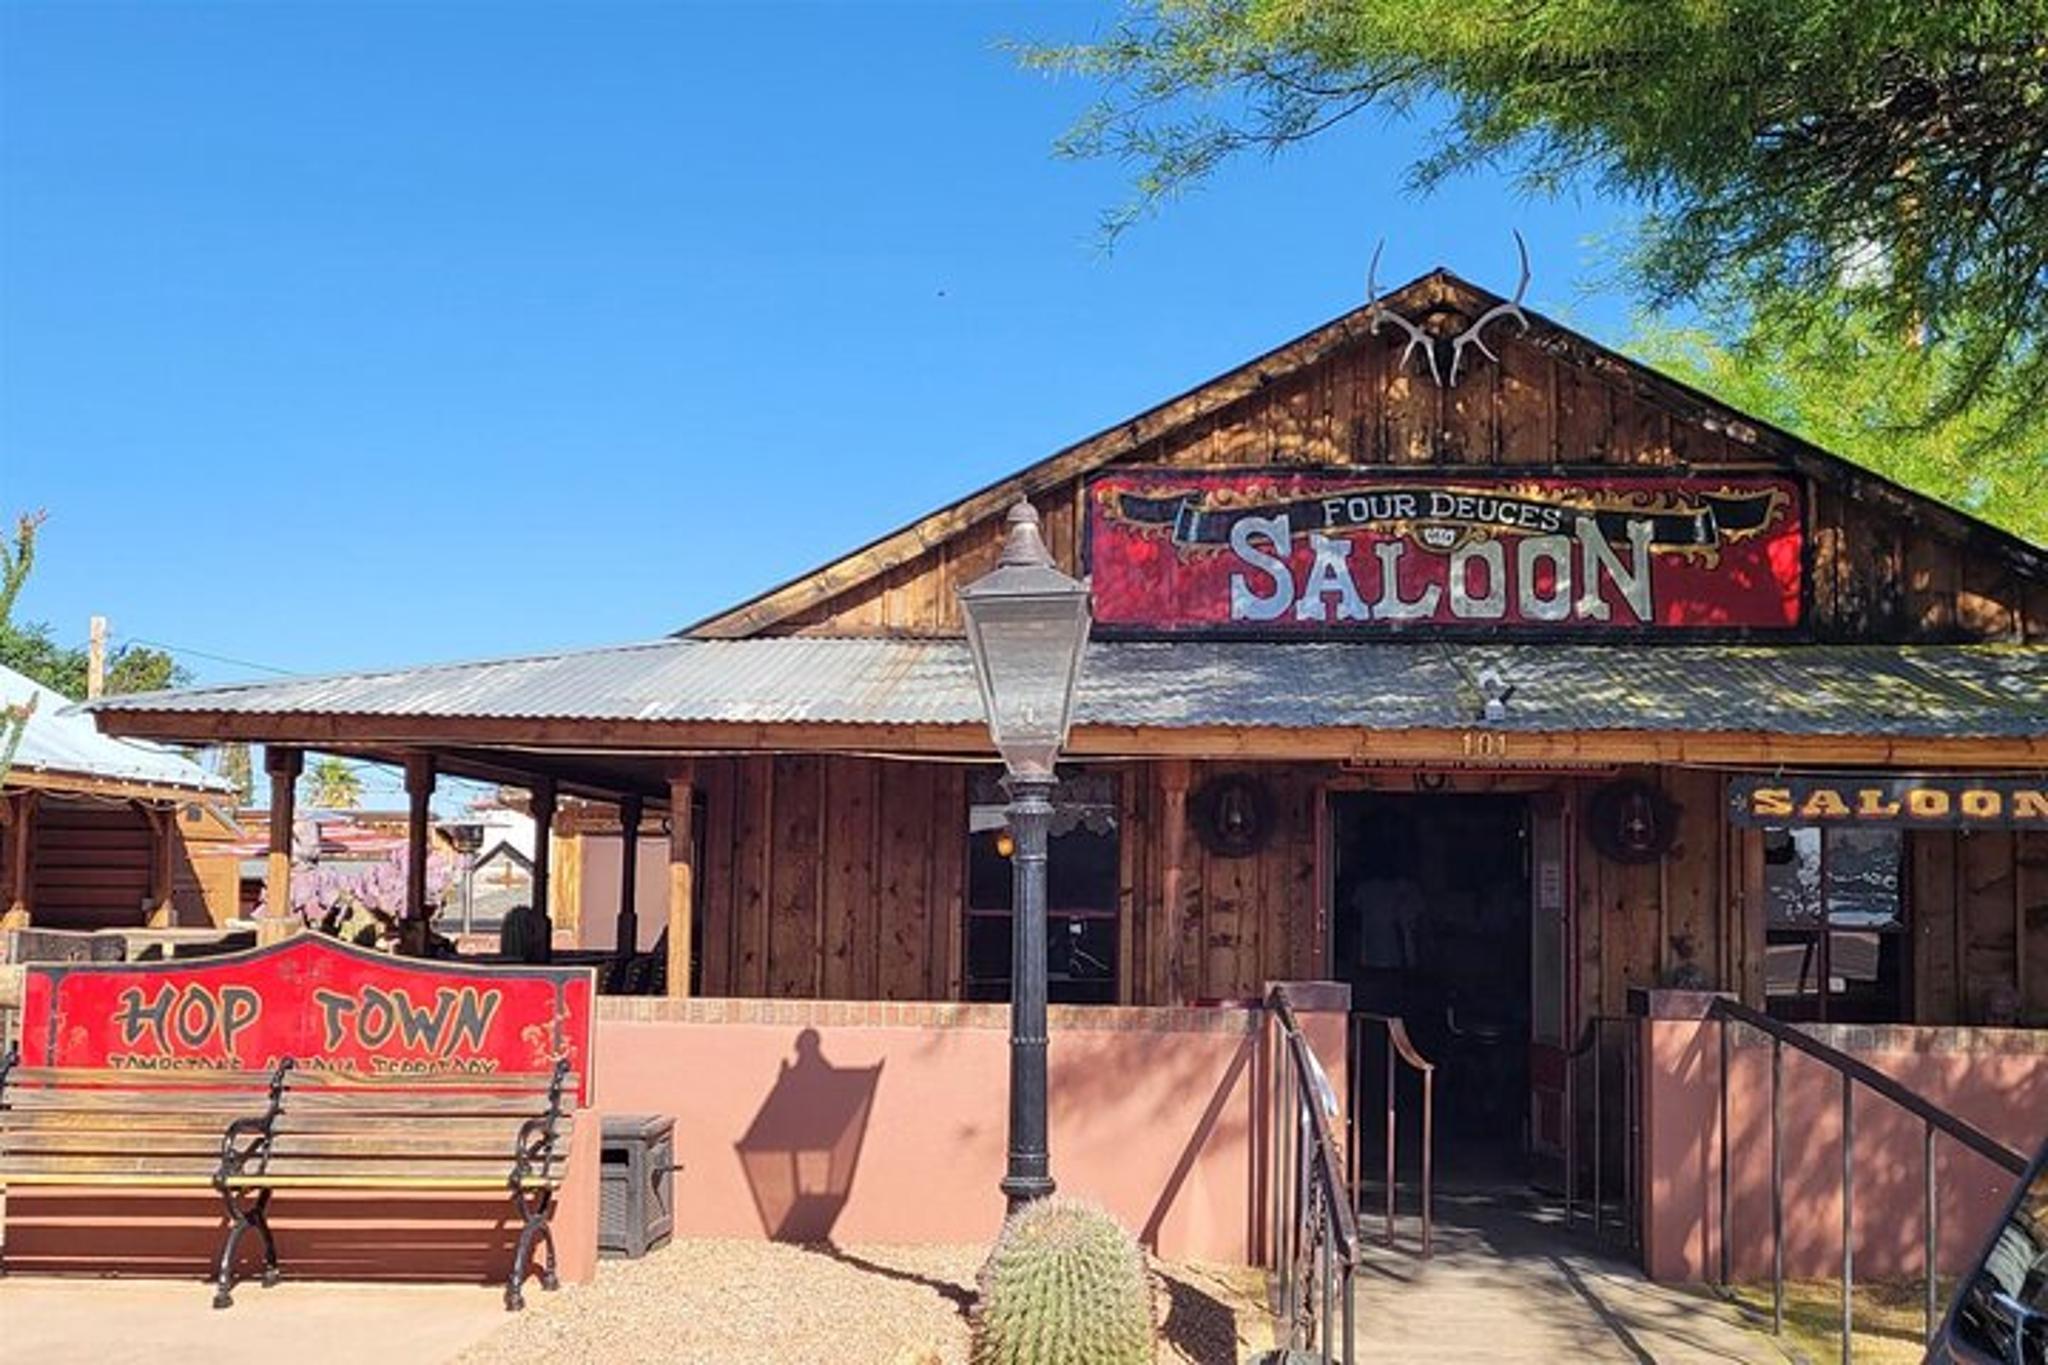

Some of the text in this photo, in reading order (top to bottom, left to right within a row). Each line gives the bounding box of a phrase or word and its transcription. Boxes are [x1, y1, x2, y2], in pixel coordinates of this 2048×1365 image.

[1322, 491, 1563, 532] FOUR DEUCES
[1230, 513, 1654, 622] SALOON
[1462, 731, 1508, 756] 101
[1752, 787, 2048, 819] SALOON
[114, 983, 501, 1055] HOP TOWN
